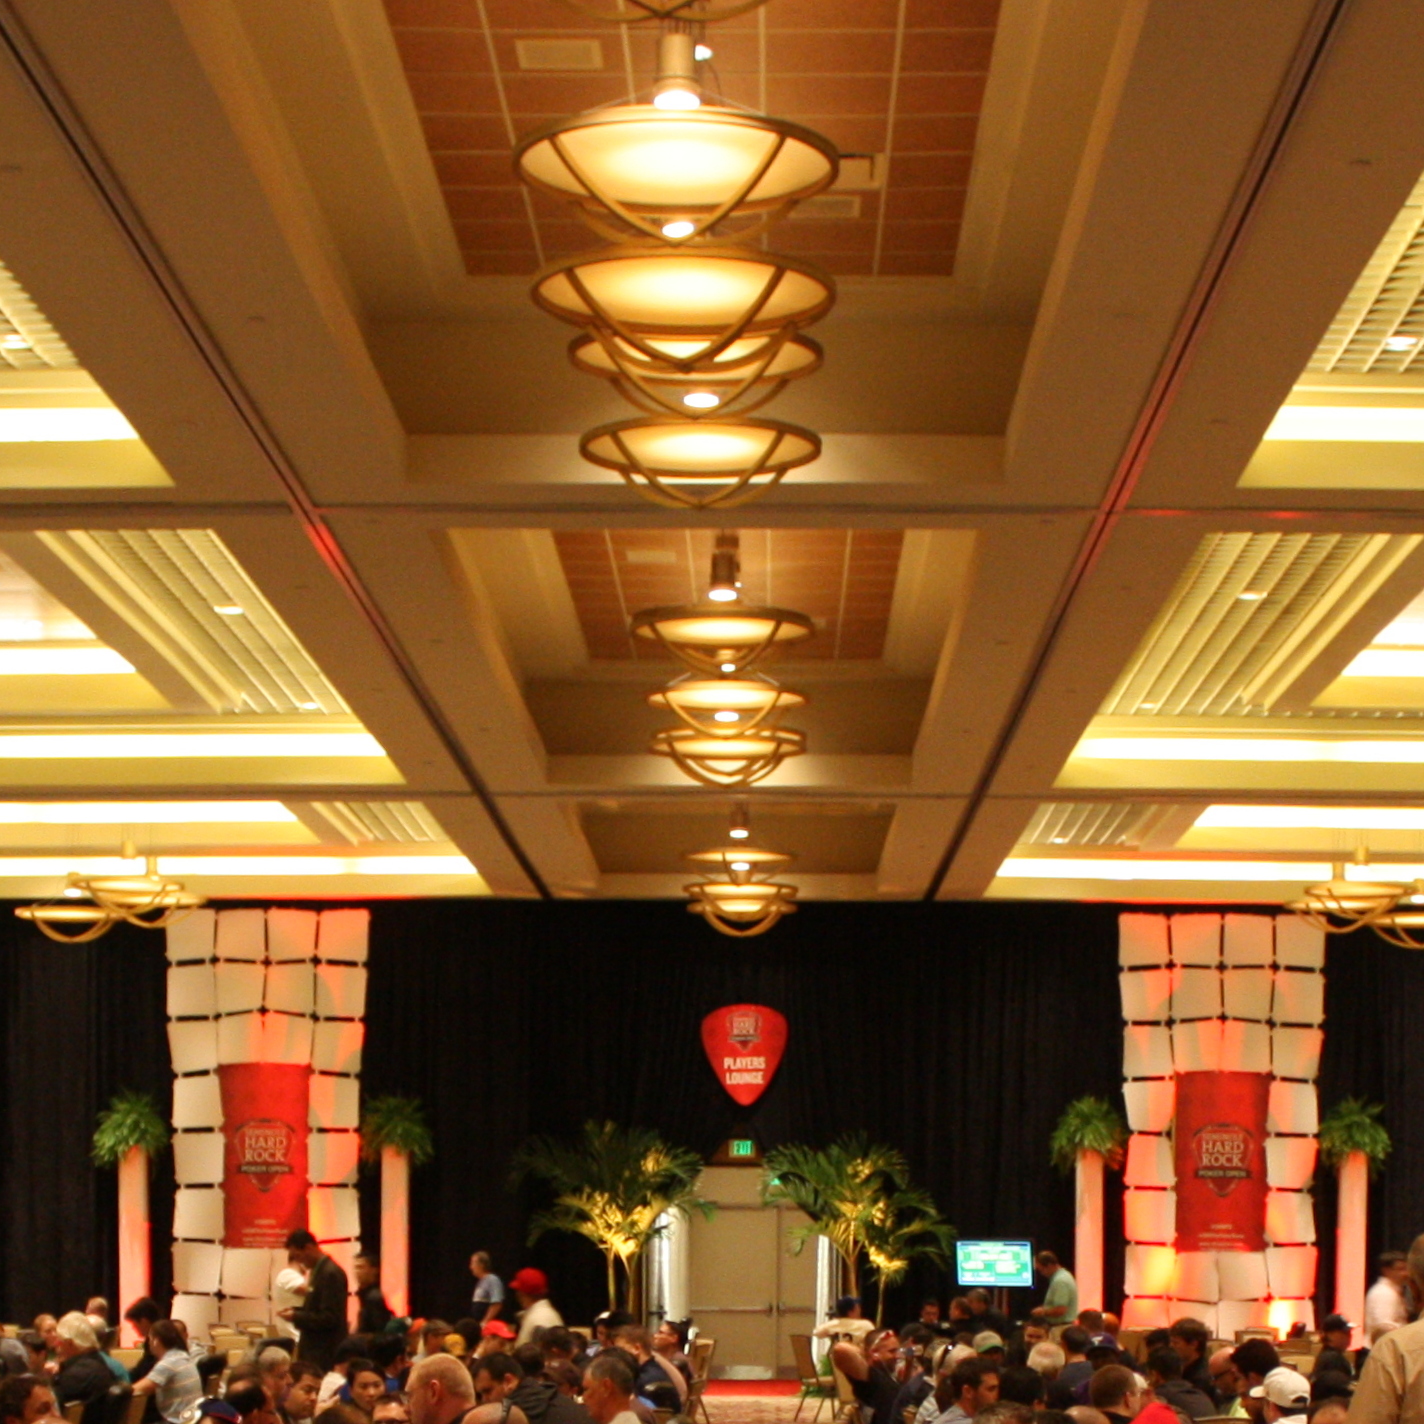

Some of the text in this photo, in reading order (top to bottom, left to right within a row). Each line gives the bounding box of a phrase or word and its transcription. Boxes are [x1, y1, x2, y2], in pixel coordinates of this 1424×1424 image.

[723, 1056, 765, 1069] PLAYERS
[725, 1071, 763, 1084] LOUNGE
[245, 1137, 286, 1148] HARD
[1202, 1141, 1244, 1153] HARD
[244, 1149, 285, 1161] ROCK
[1202, 1154, 1242, 1166] ROCK
